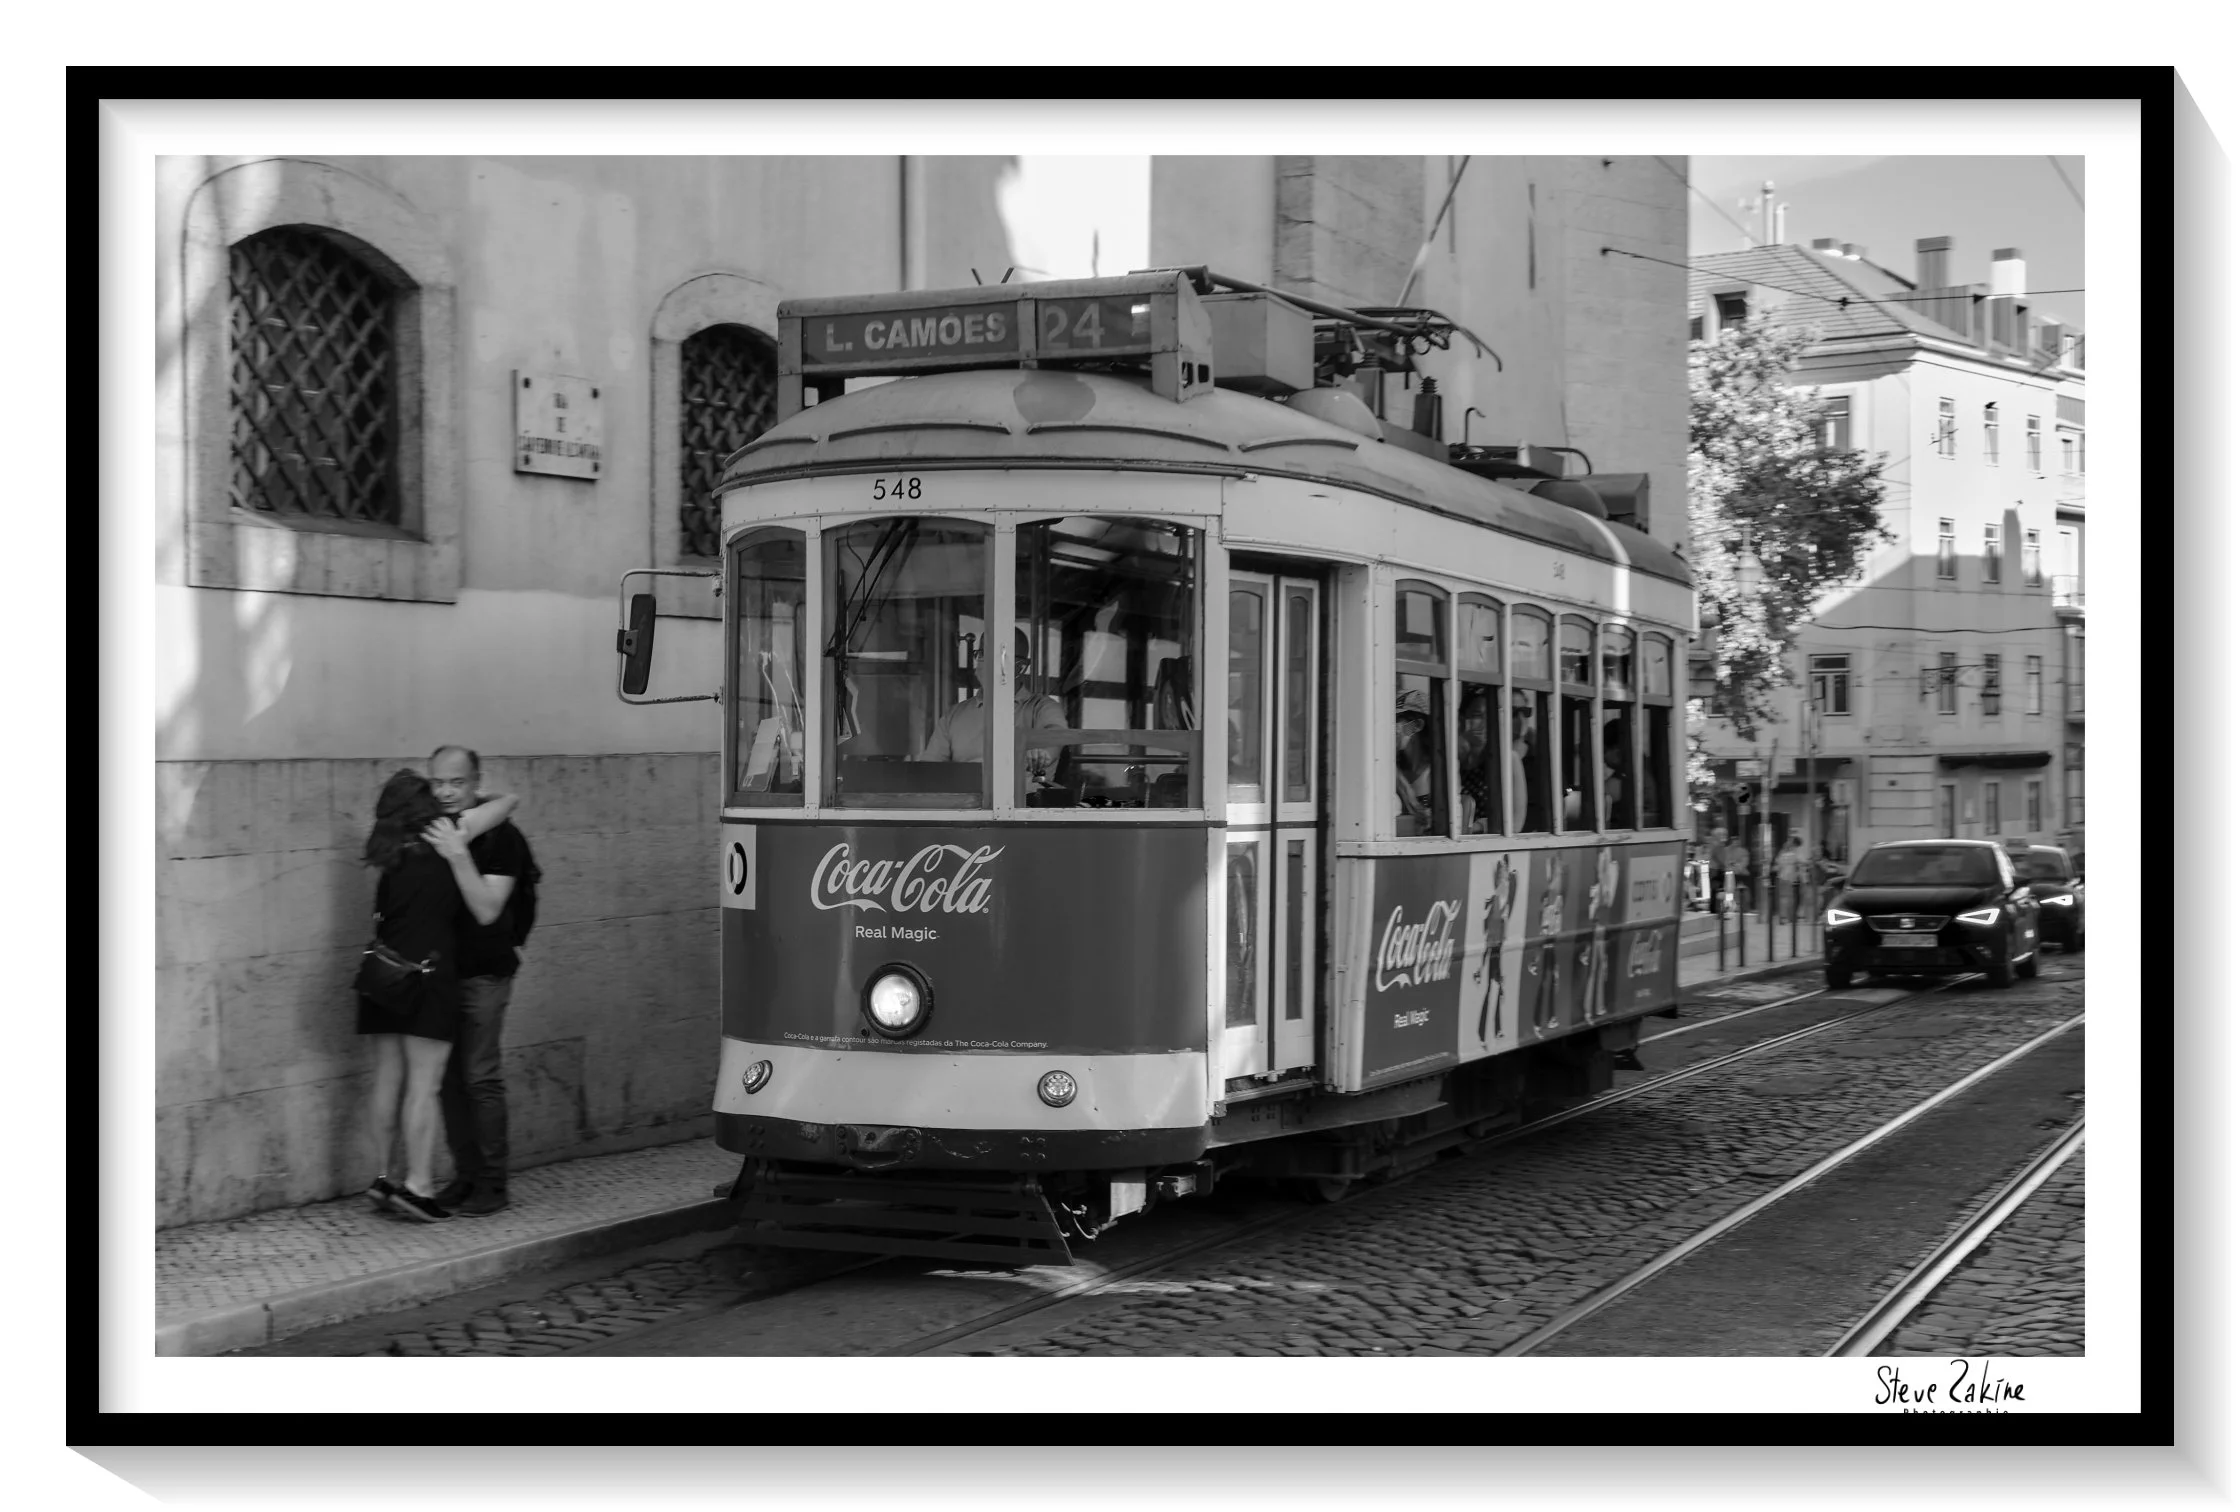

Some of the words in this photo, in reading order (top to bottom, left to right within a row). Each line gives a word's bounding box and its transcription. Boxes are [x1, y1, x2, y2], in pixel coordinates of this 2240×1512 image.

[825, 323, 853, 353] L.
[1044, 303, 1106, 348] 24
[873, 477, 922, 500] 548
[811, 842, 1005, 914] Coca-Cola
[855, 925, 887, 939] Real
[891, 926, 937, 942] Magic
[783, 1031, 810, 1041] Coca-Cola
[841, 1036, 866, 1044] contour
[906, 1039, 942, 1047] registadas
[943, 1039, 953, 1047] da
[970, 1040, 1009, 1048] Coca-Cola
[1010, 1040, 1049, 1049] Company.
